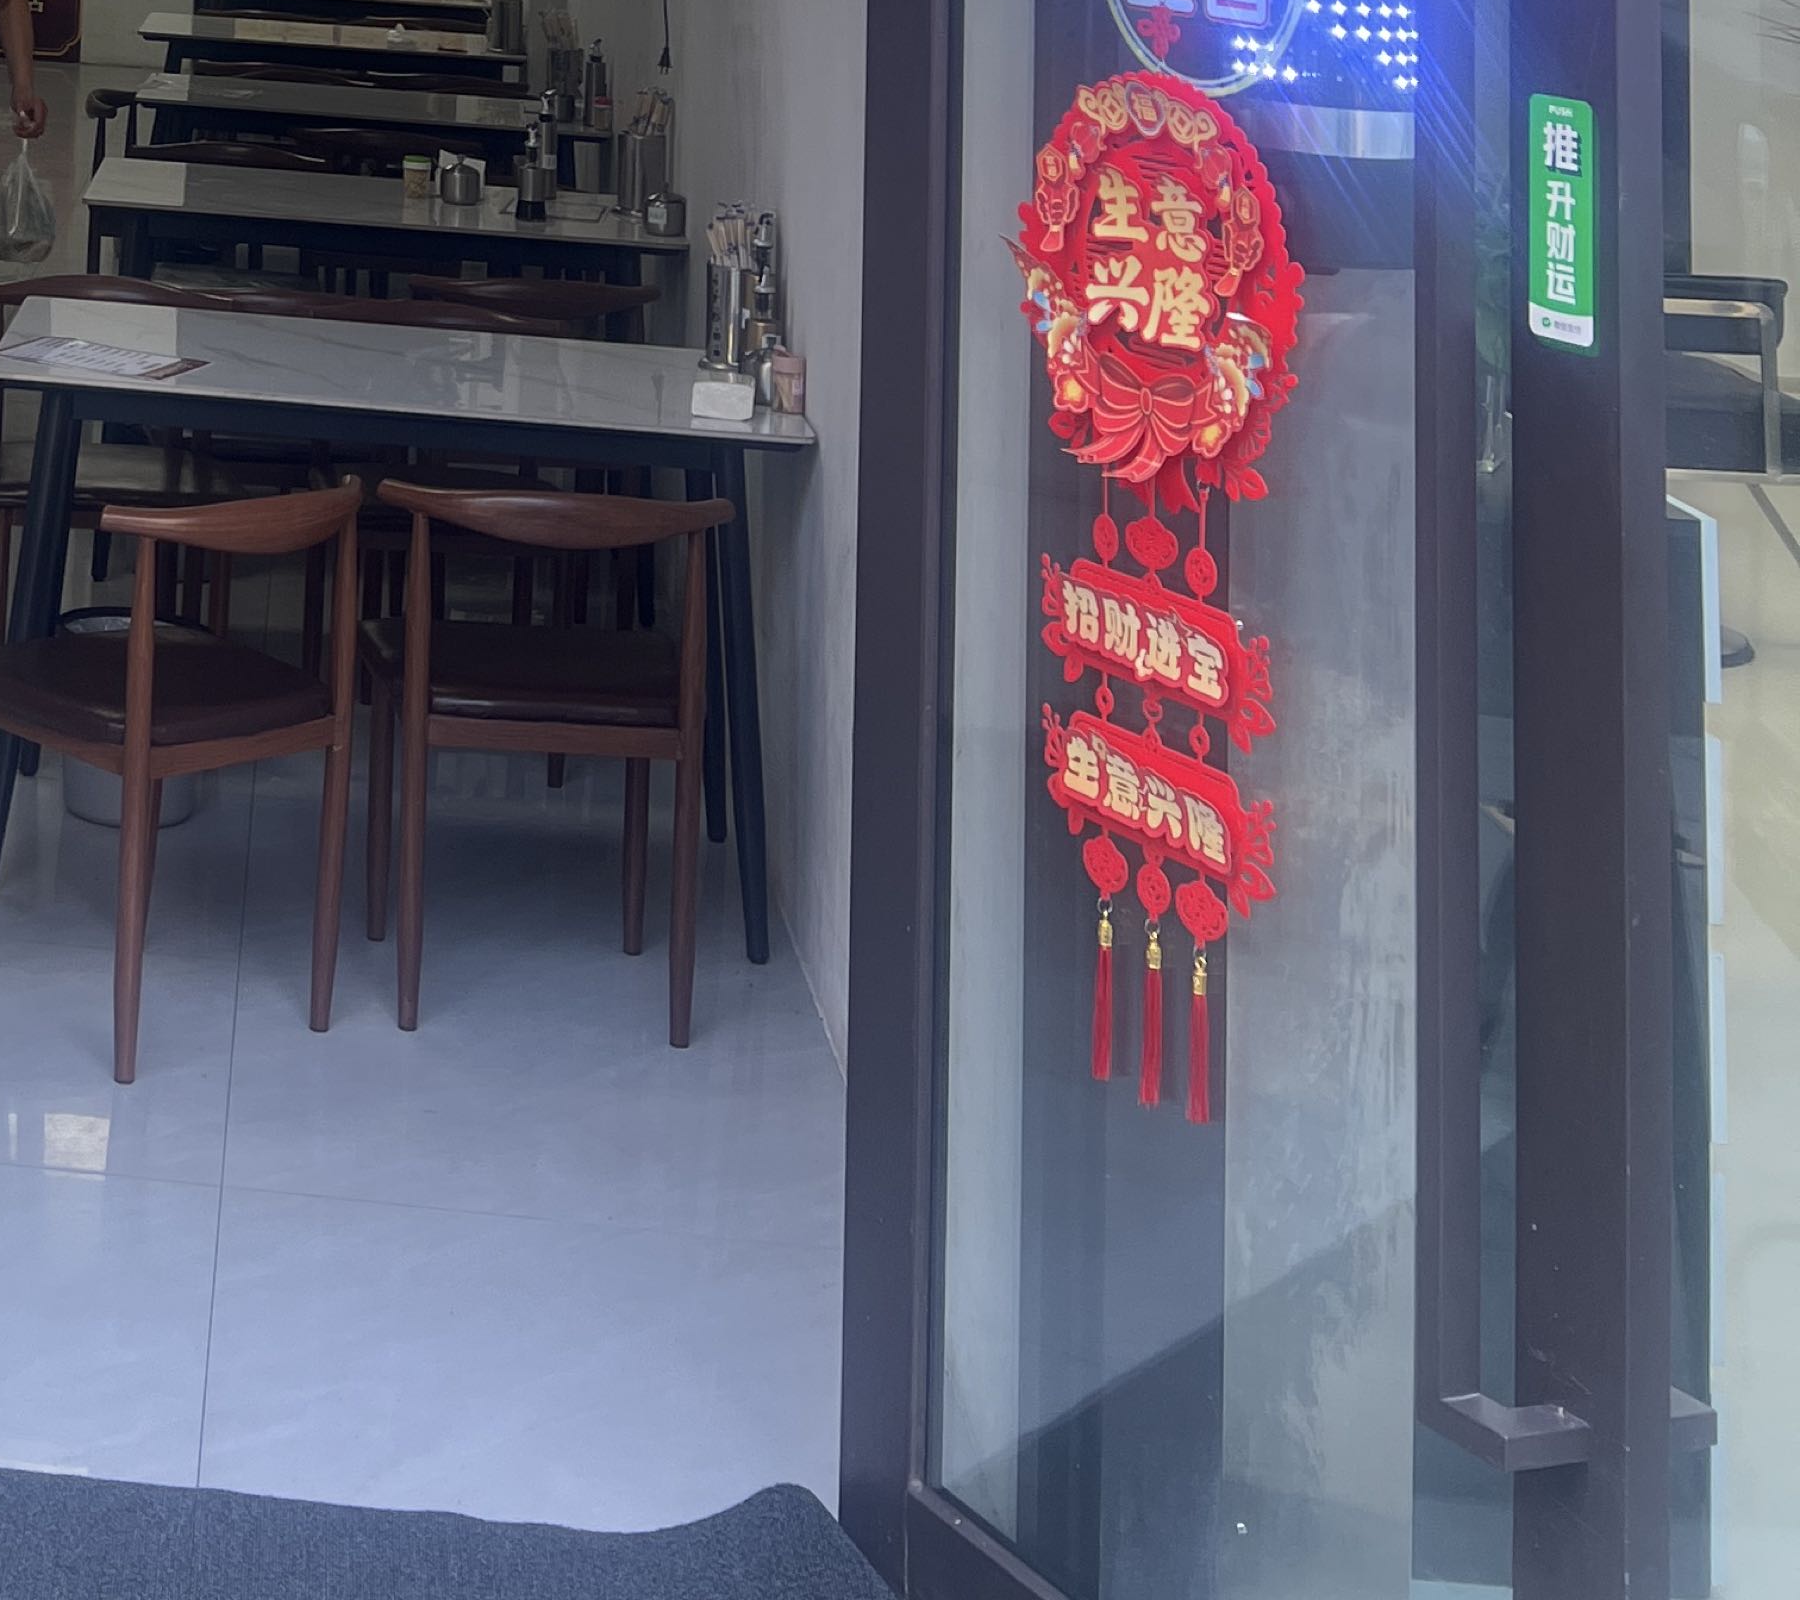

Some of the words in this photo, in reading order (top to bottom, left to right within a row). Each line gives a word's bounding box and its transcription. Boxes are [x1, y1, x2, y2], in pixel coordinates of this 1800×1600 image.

[1092, 169, 1208, 263] 生意
[1084, 256, 1210, 349] 兴隆
[1063, 580, 1224, 700] 招财进宝
[1063, 736, 1226, 864] 生意兴隆
